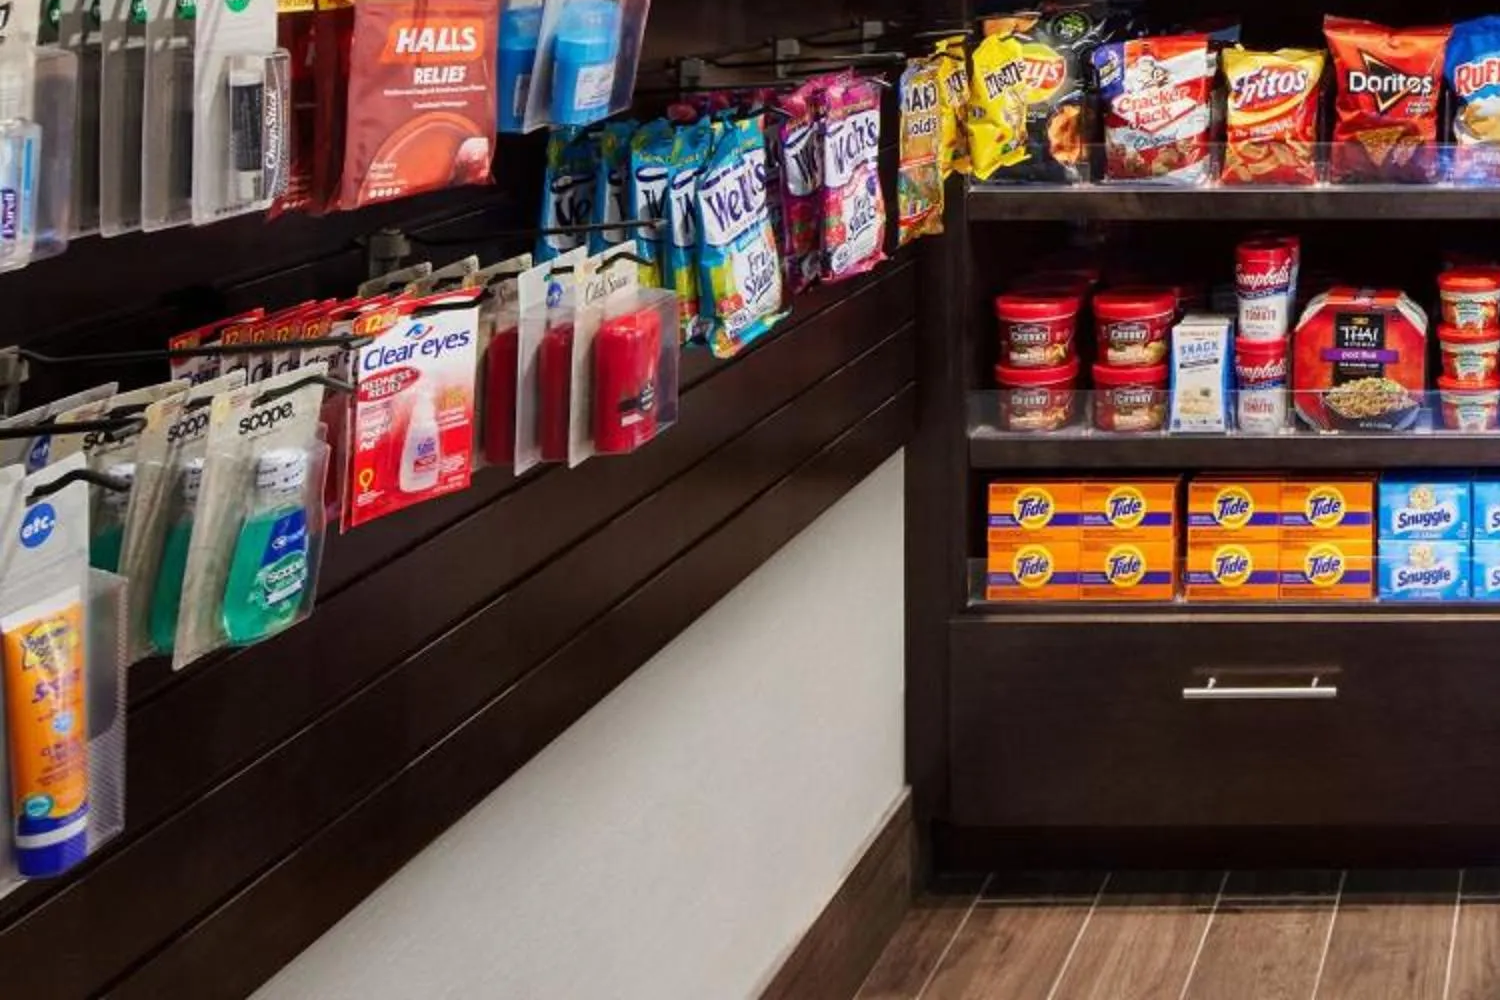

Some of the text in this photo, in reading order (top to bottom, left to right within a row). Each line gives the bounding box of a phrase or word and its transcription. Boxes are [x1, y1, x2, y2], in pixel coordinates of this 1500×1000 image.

[396, 26, 478, 54] HALLS
[413, 65, 467, 85] RELIEF
[1349, 71, 1433, 94] Doritos
[1230, 65, 1309, 110] Fritos
[265, 88, 281, 170] ChapStick
[1131, 106, 1173, 131] Jack
[1339, 325, 1379, 342] THAI
[363, 341, 418, 371] Clear
[421, 329, 471, 358] eyes
[239, 400, 293, 436] scope
[1017, 495, 1050, 521] Tide
[1109, 495, 1142, 521] Tide
[1216, 495, 1249, 521] Tide
[1309, 496, 1342, 520] Tide
[1397, 506, 1452, 529] Snuggle
[22, 515, 55, 540] etc.
[1016, 555, 1049, 579] Tide
[1109, 555, 1142, 579] Tide
[1215, 555, 1248, 579] Tide
[1307, 555, 1341, 579] Tide
[1397, 564, 1451, 587] Snuggle
